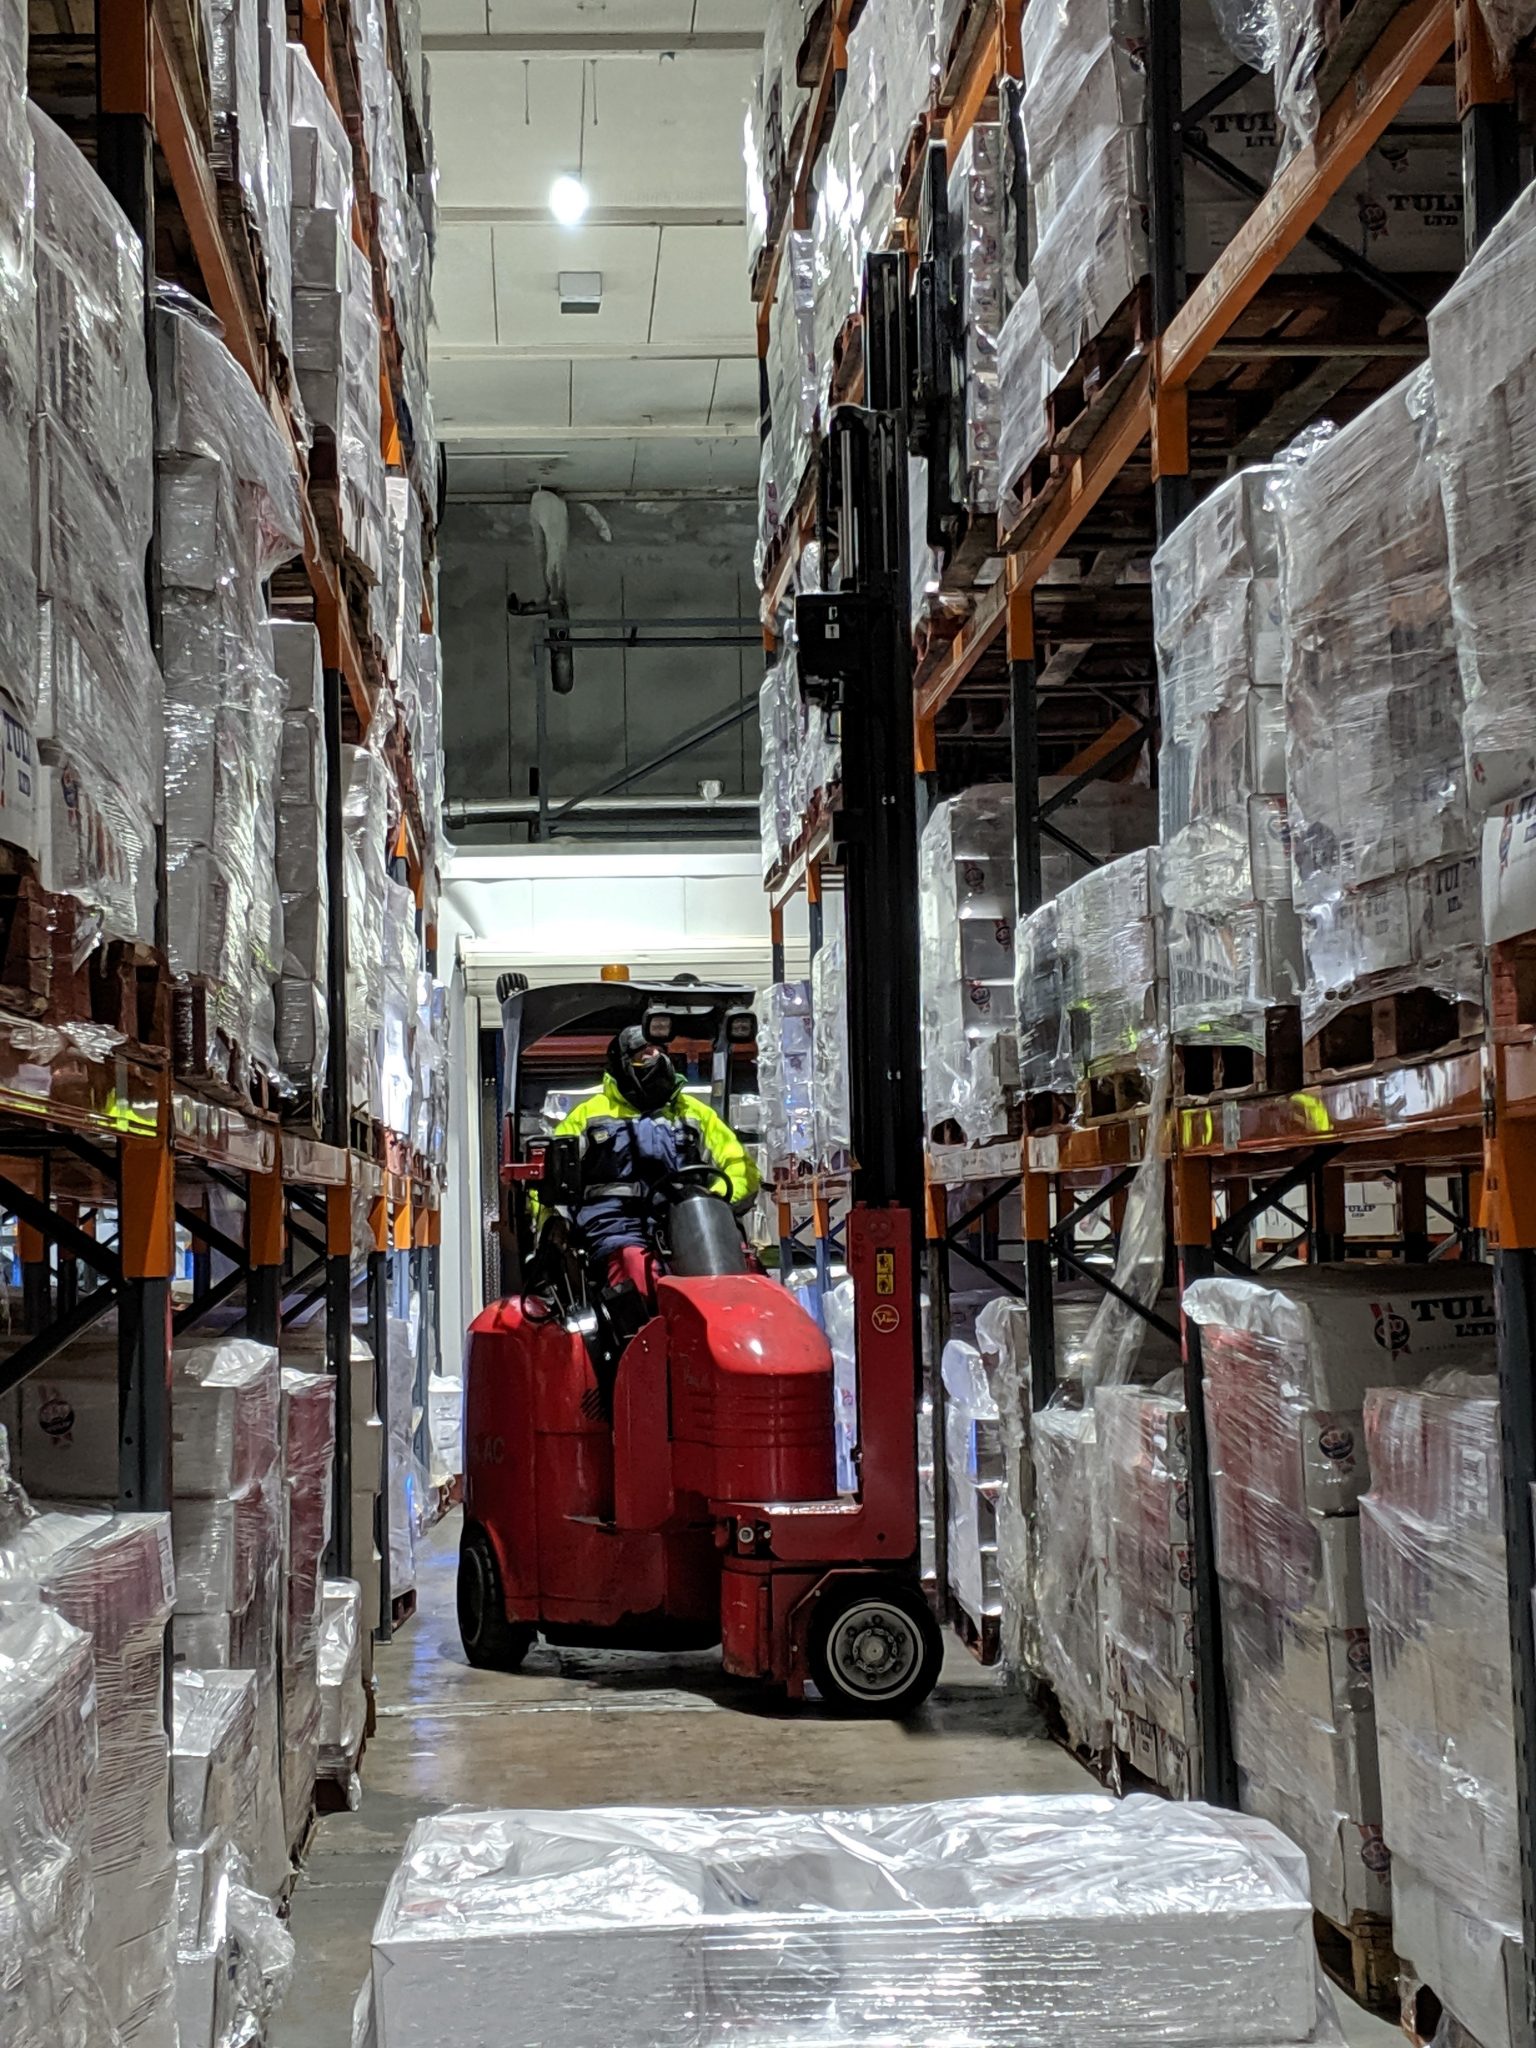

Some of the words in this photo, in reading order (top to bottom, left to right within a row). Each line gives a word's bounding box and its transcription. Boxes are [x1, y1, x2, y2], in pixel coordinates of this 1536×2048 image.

[1209, 111, 1276, 133] TUL
[1424, 215, 1458, 226] LTD
[1345, 1204, 1376, 1213] ULIP
[1455, 1322, 1496, 1337] LTD
